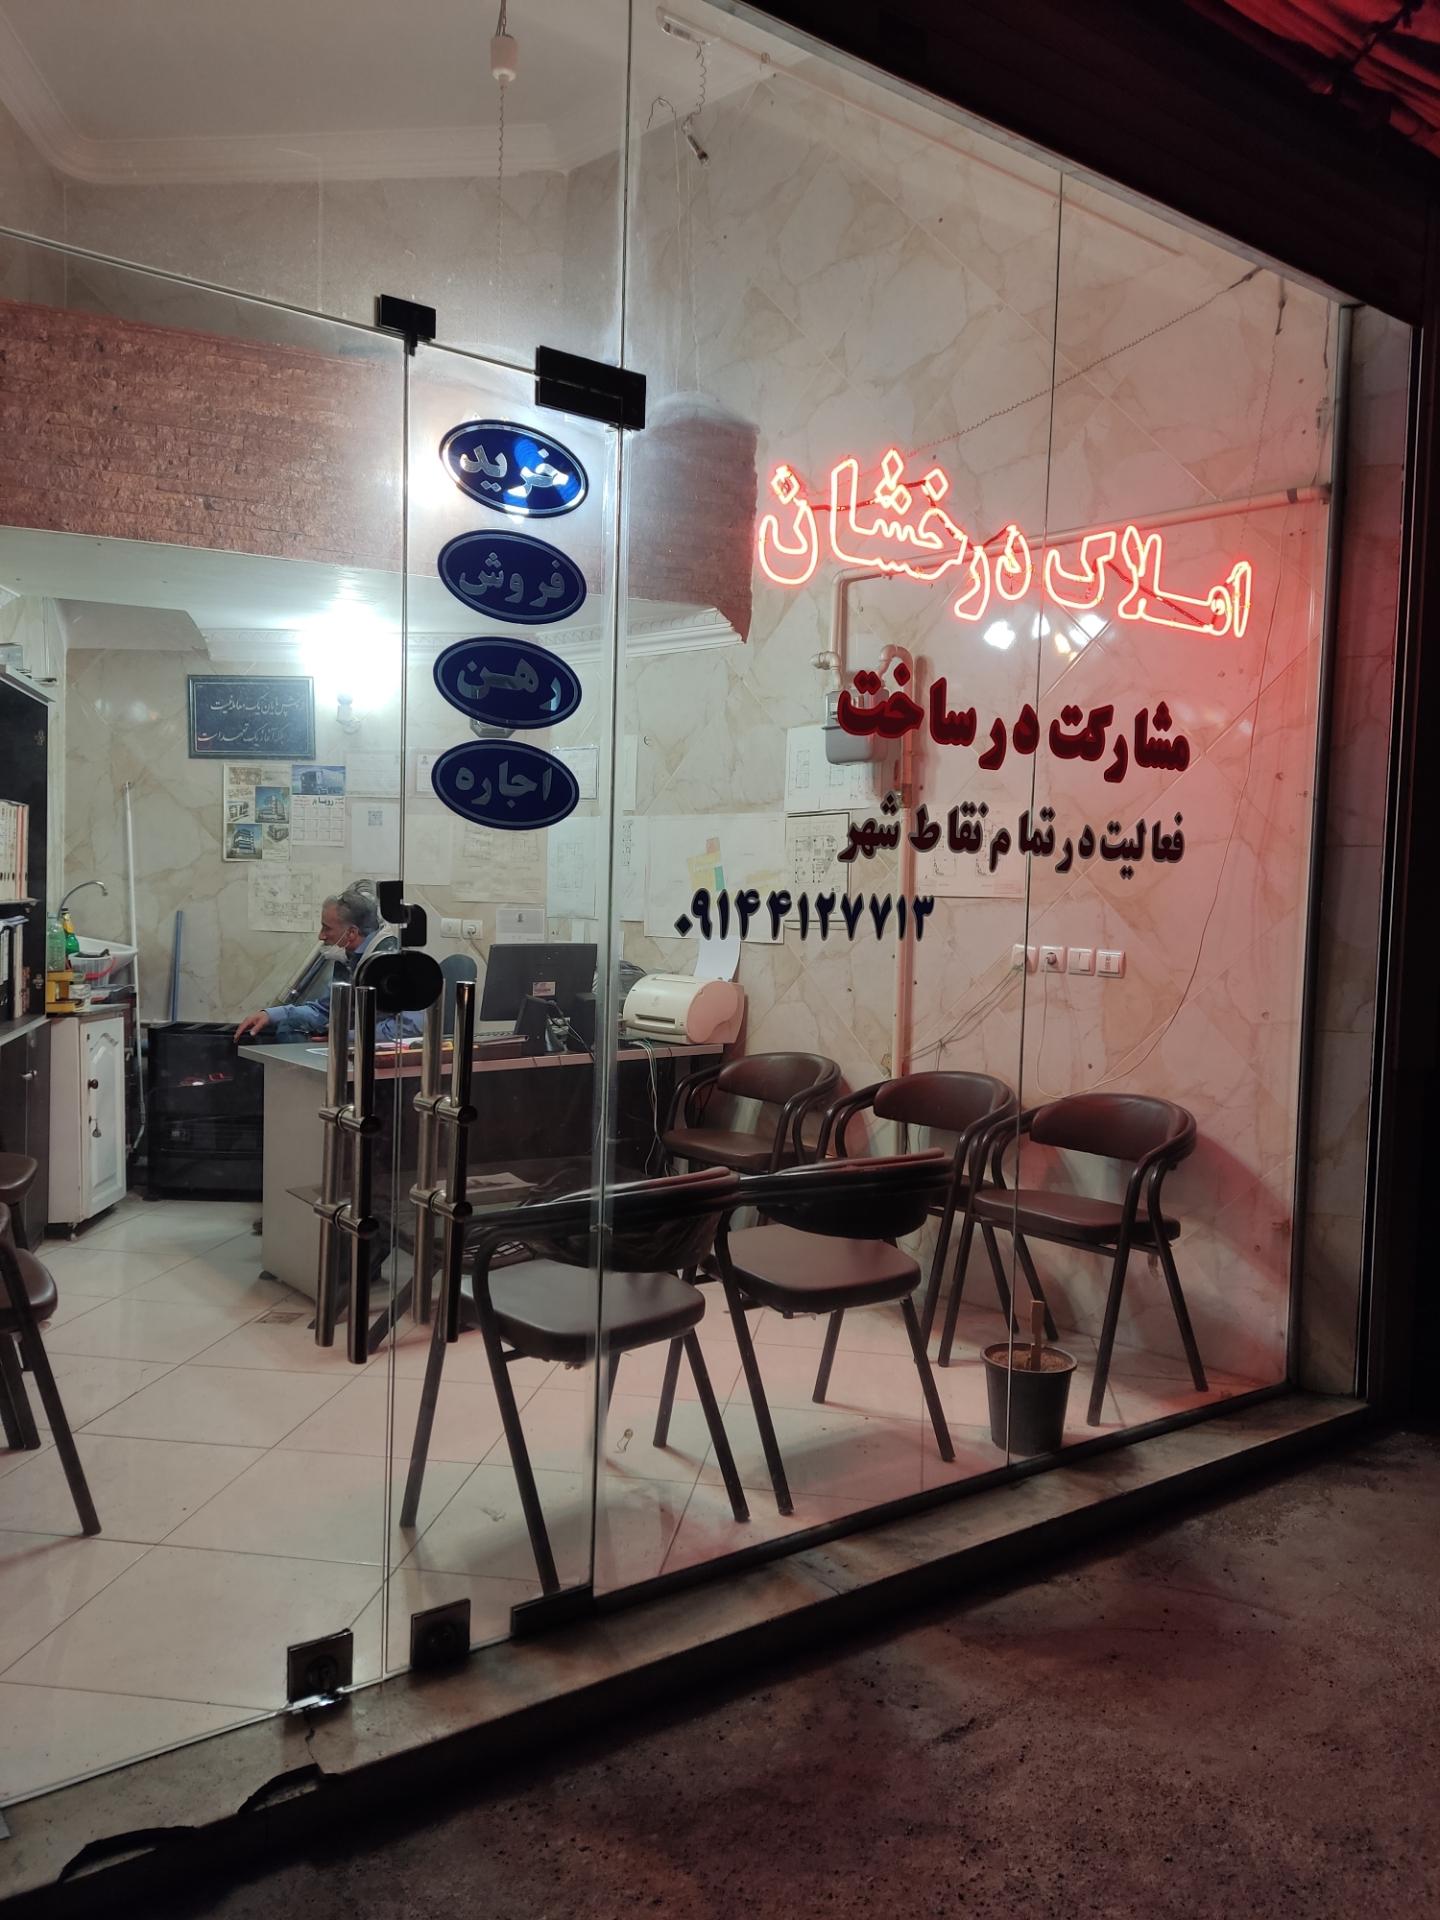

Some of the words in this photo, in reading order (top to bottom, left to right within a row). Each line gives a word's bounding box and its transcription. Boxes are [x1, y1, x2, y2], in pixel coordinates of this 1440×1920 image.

[459, 445, 570, 498] خرید
[758, 447, 1033, 622] درخشان
[458, 552, 566, 608] فروش
[1043, 524, 1253, 638] املاک
[456, 658, 562, 712] رهن
[836, 663, 977, 745] ساخت
[978, 704, 1040, 770] در
[1048, 702, 1190, 783] مشارکت
[455, 760, 553, 808] اجاره
[837, 790, 901, 862] شهر
[908, 799, 990, 855] نقاط
[988, 806, 1056, 872] تمام
[1054, 824, 1094, 873] در
[1099, 811, 1185, 879] فعالیت
[674, 886, 935, 941] ۰۹۱۴۴۱۲۷۷۱۳
